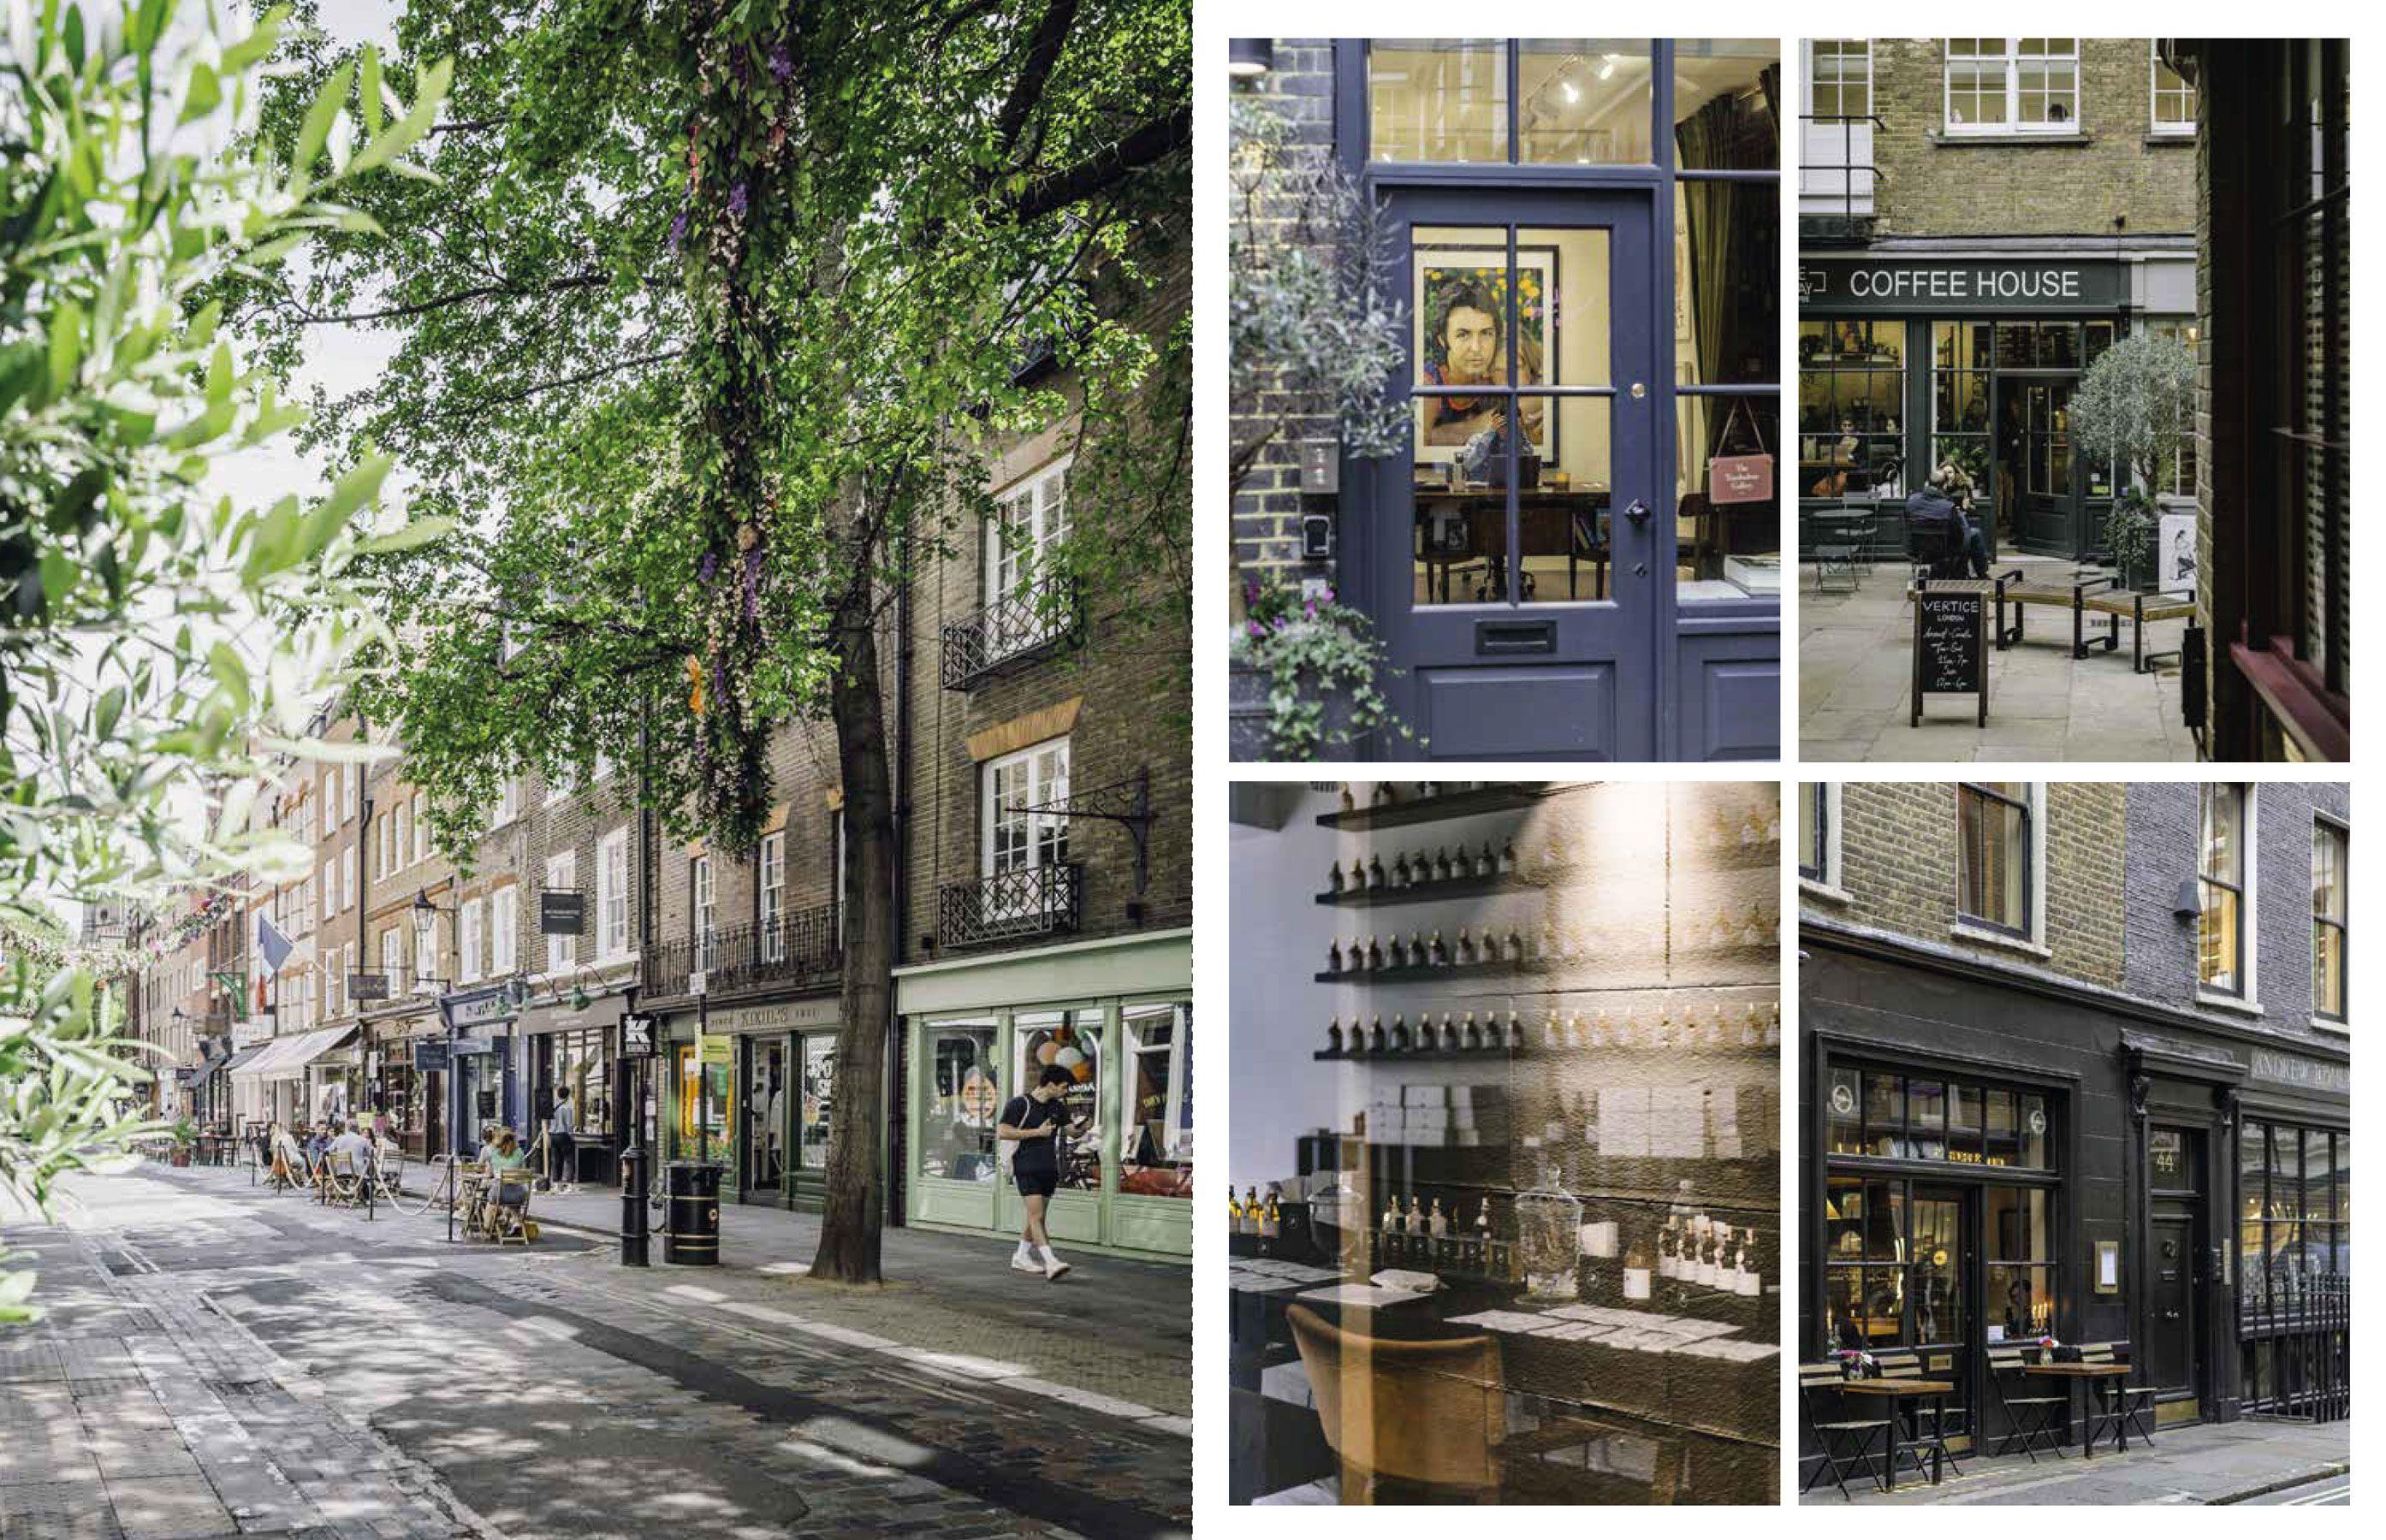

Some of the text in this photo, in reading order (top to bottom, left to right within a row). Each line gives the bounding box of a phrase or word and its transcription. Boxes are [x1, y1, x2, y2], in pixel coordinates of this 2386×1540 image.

[1849, 270, 2080, 297] COFFEE HOUSE
[1922, 600, 1979, 613] VERTICE
[2157, 1152, 2175, 1172] 44
